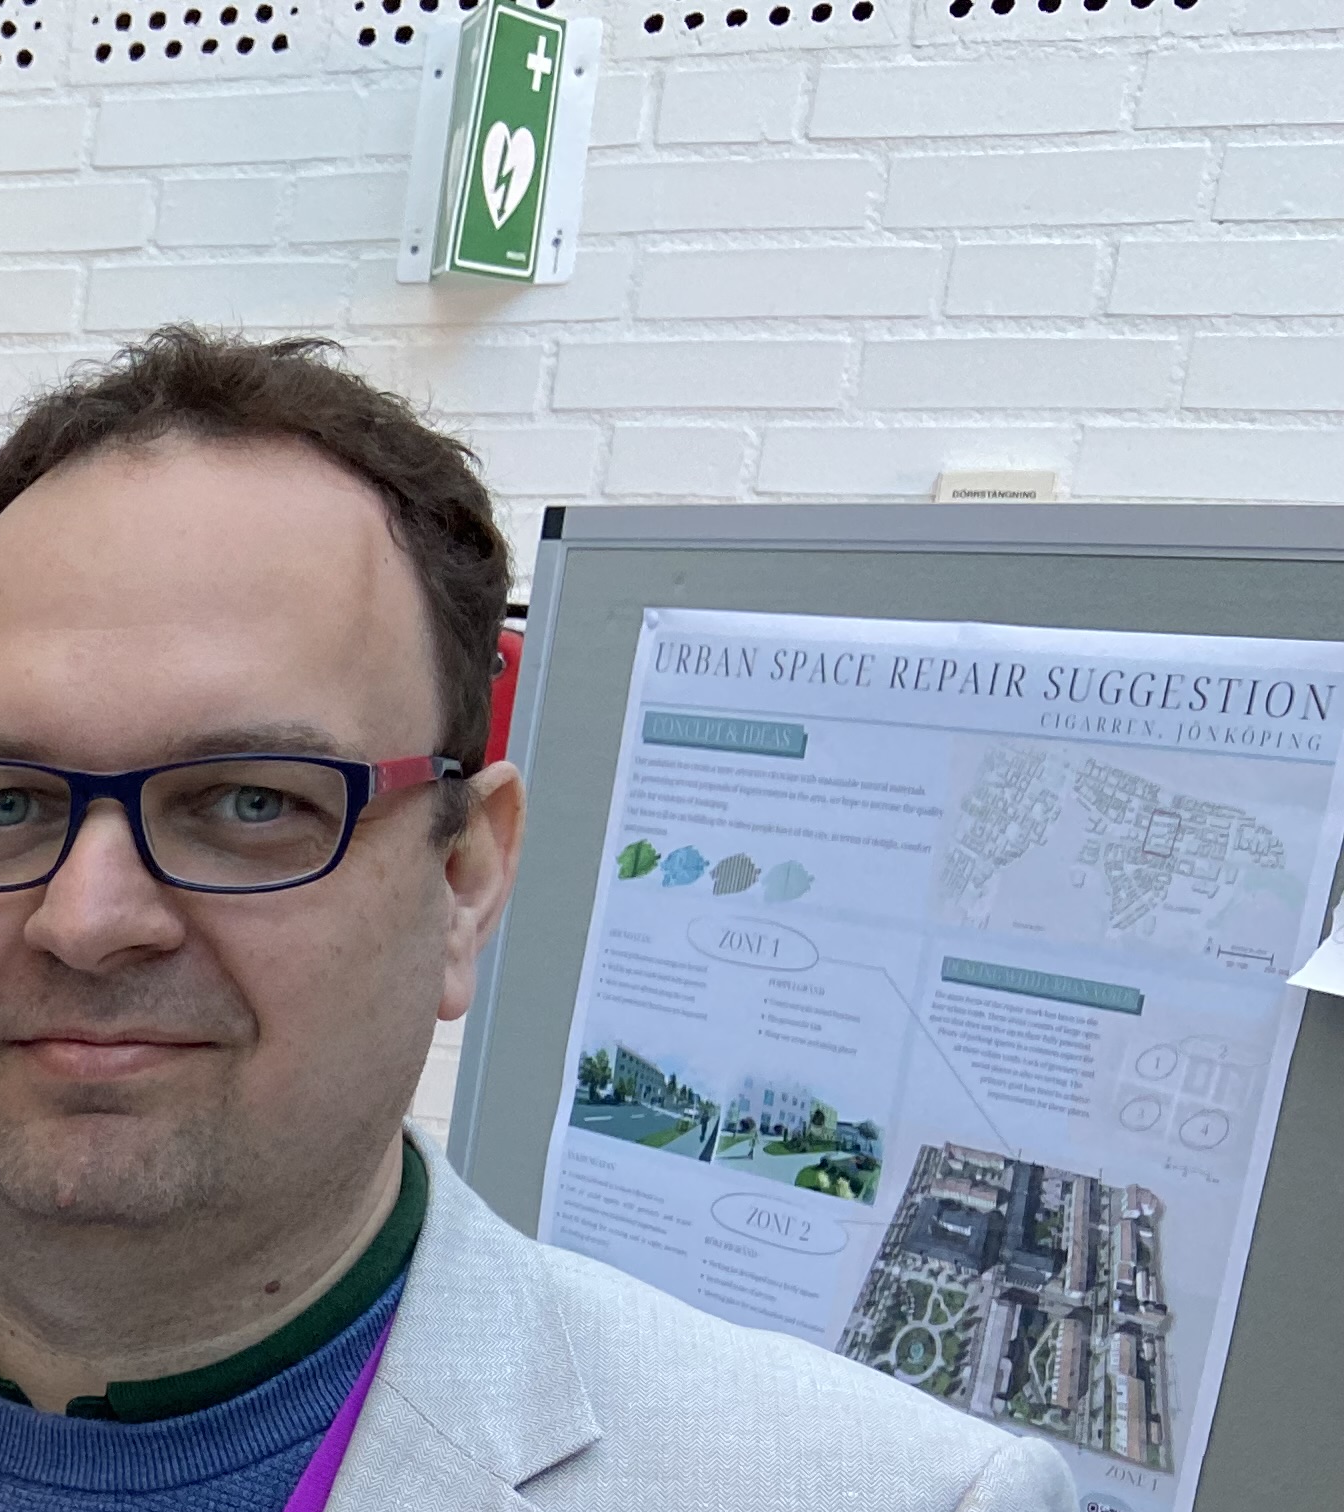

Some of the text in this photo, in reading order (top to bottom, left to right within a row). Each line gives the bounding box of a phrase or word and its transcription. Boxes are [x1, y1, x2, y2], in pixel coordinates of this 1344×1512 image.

[654, 640, 1338, 724] URBAN SPACE REPAIR SUGGESTION
[1040, 710, 1323, 753] CIGARREN, JÖNKÖPING
